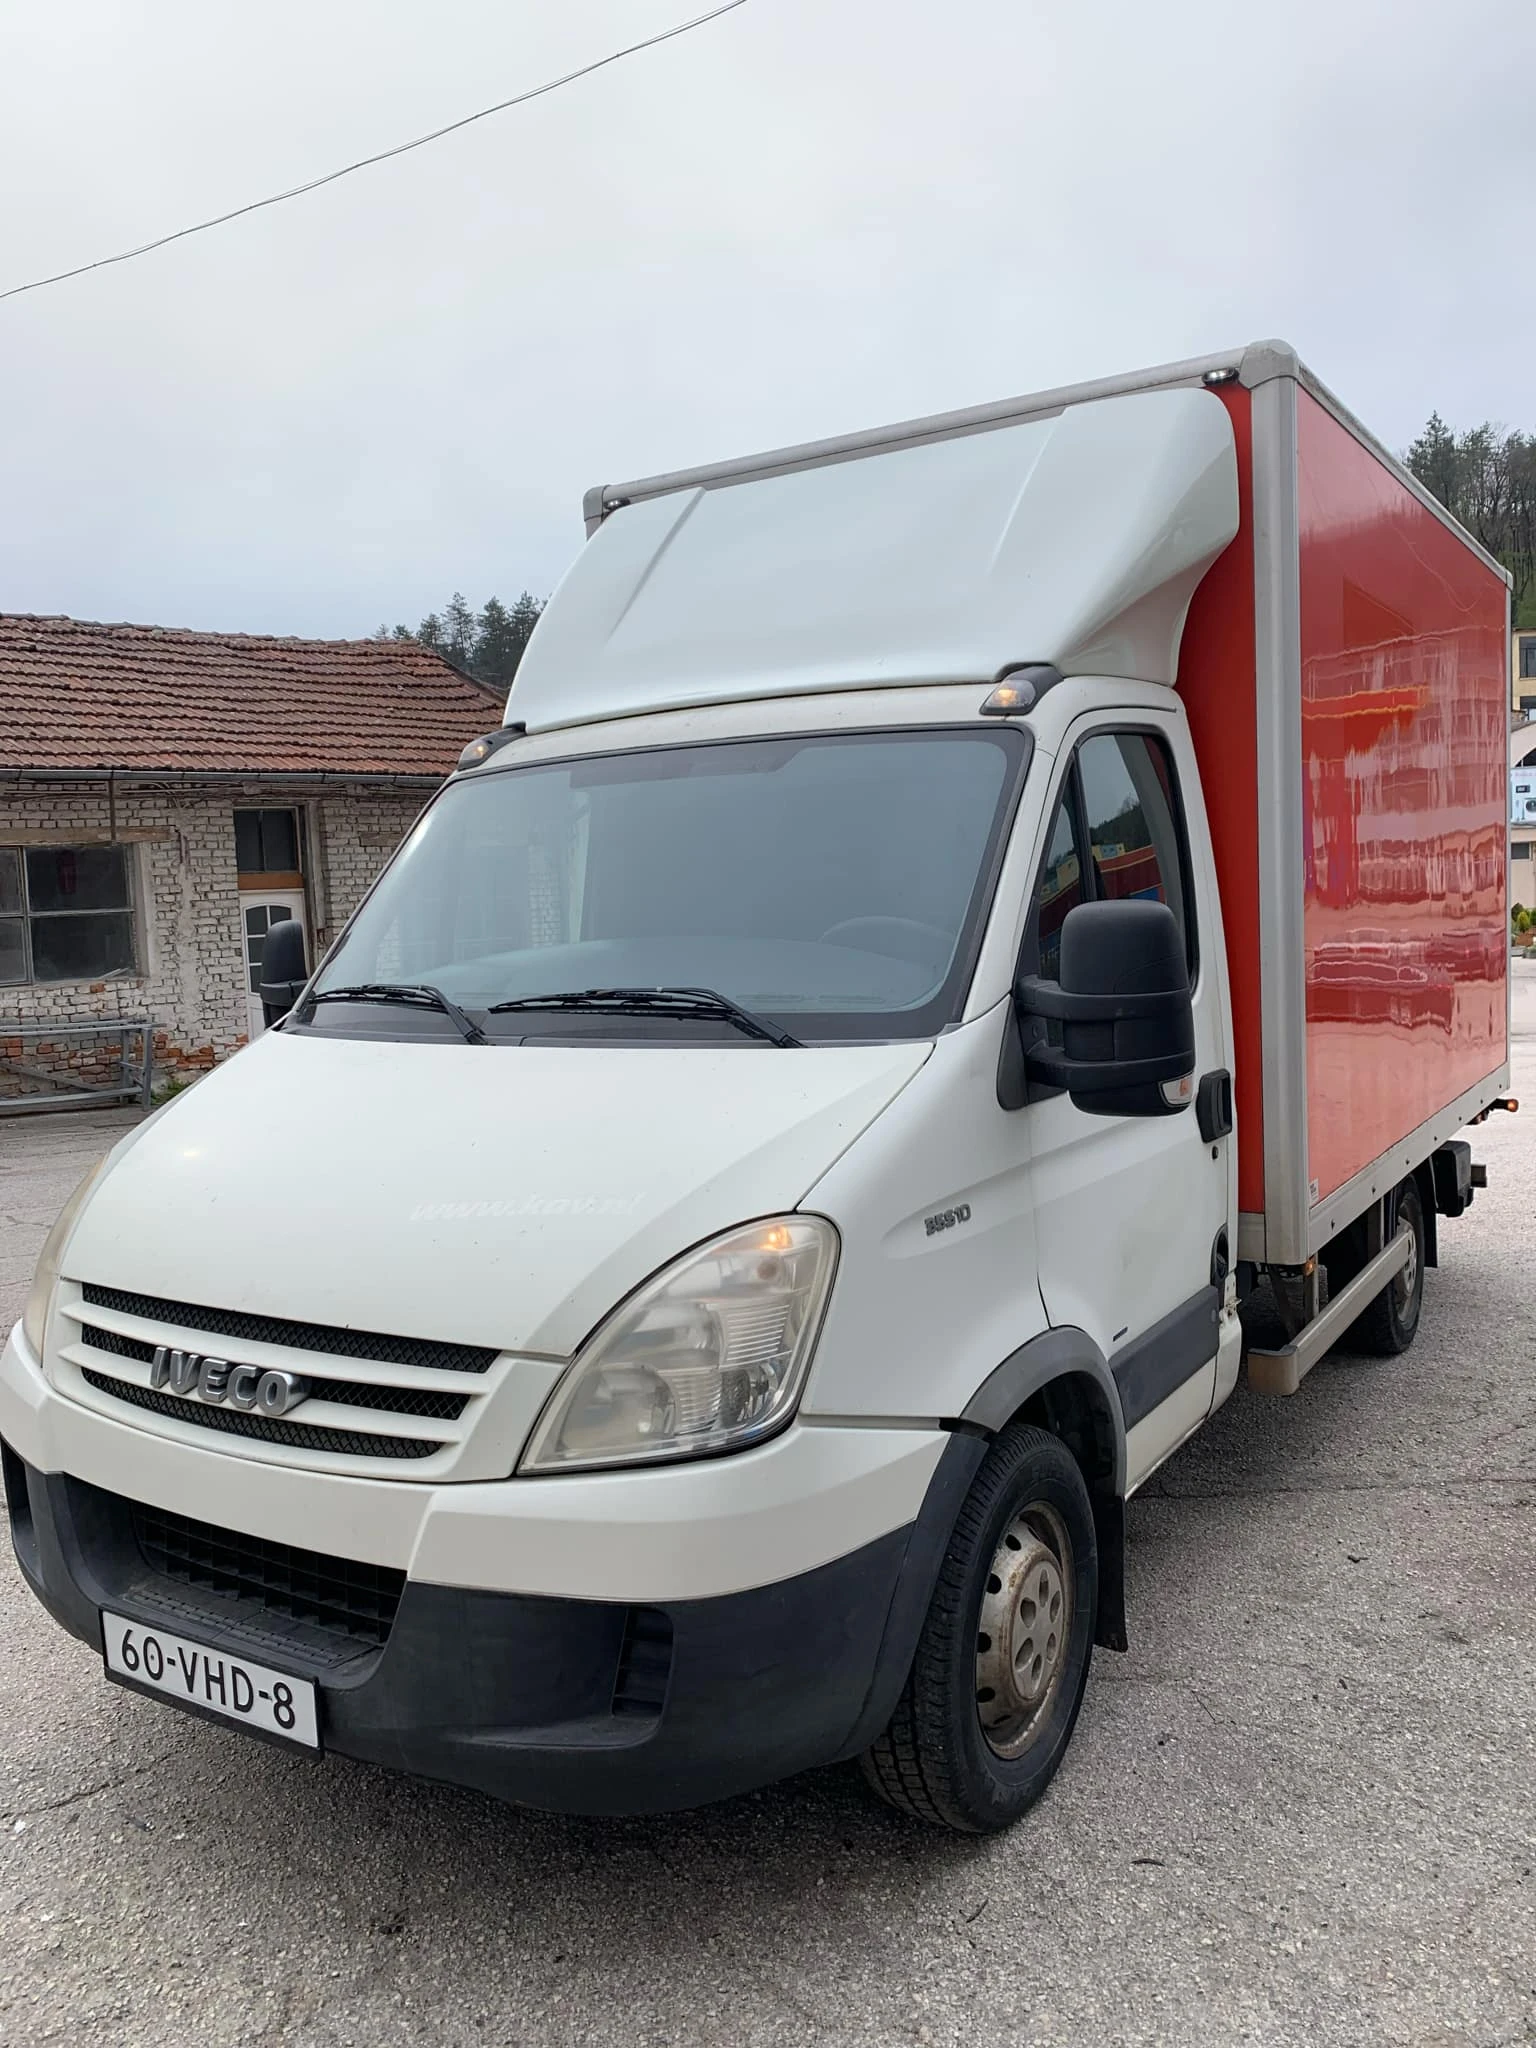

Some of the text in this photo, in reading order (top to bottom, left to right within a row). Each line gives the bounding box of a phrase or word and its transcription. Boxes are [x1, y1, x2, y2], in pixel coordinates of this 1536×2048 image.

[924, 1204, 971, 1236] 35S10
[150, 1346, 304, 1416] IVECO
[121, 1629, 295, 1730] 60-VHD-8
